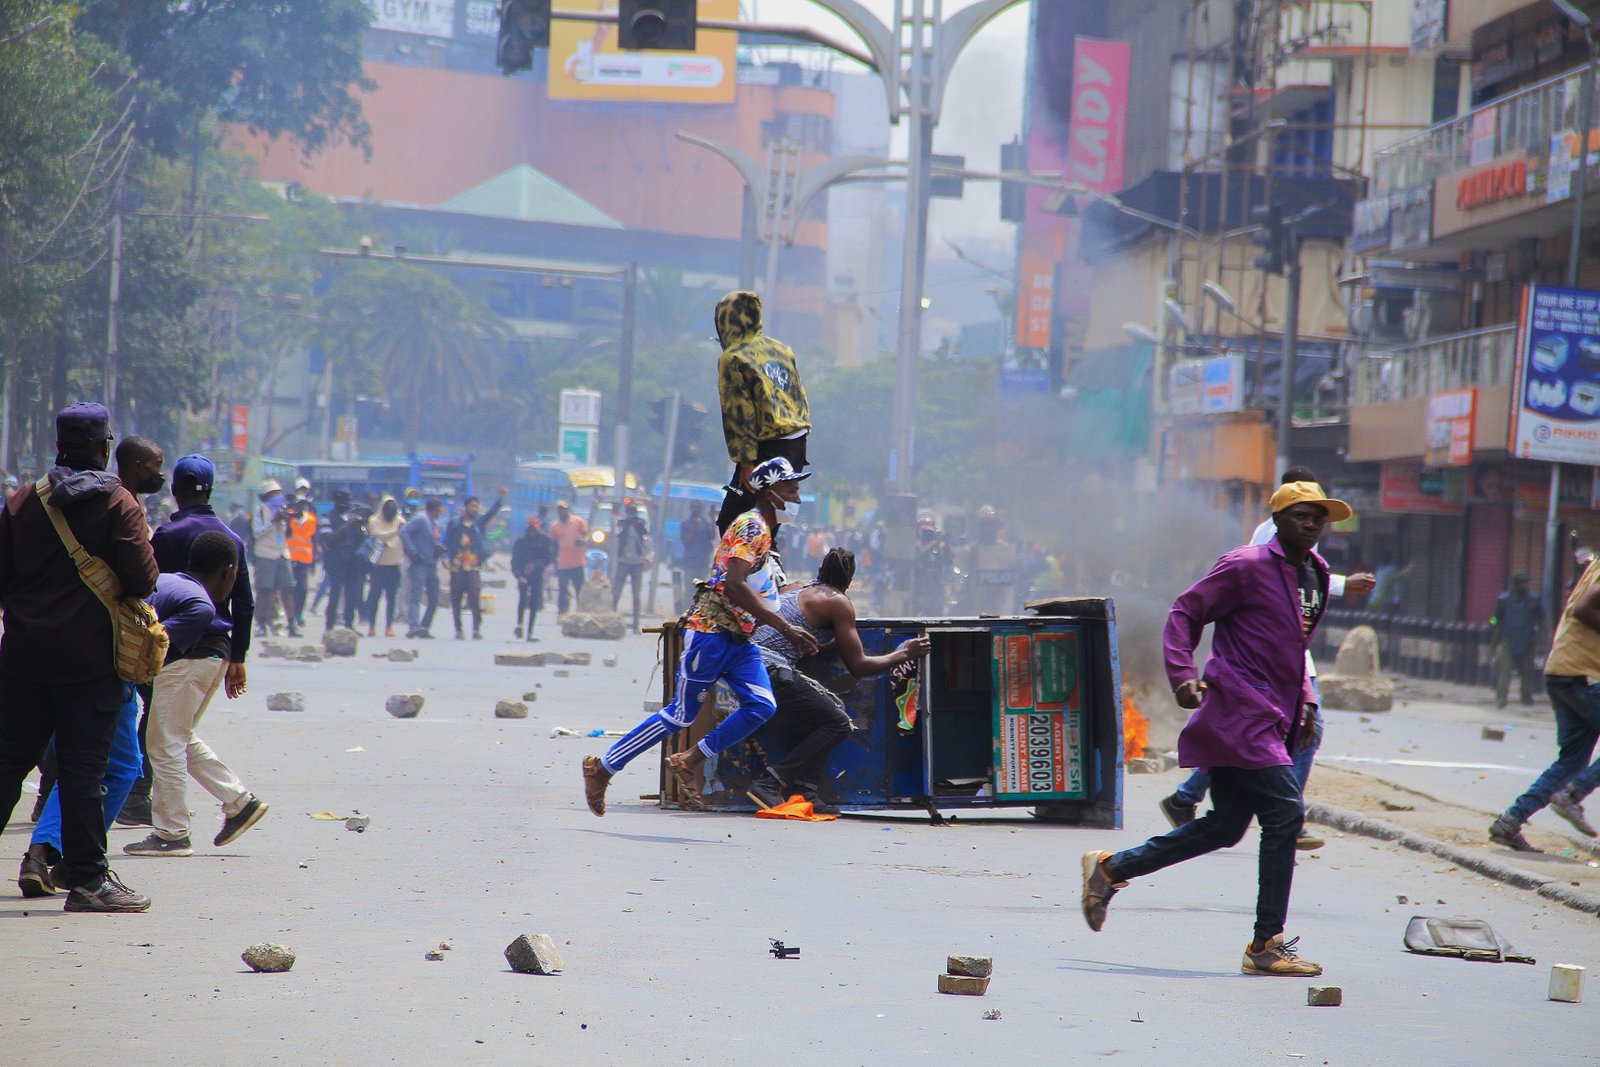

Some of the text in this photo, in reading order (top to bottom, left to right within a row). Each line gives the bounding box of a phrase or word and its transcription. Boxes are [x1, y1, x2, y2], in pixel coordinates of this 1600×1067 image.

[1019, 717, 1029, 791] AGENT NAME
[1029, 715, 1052, 792] 2039603
[1054, 721, 1063, 785] AGENT NO.
